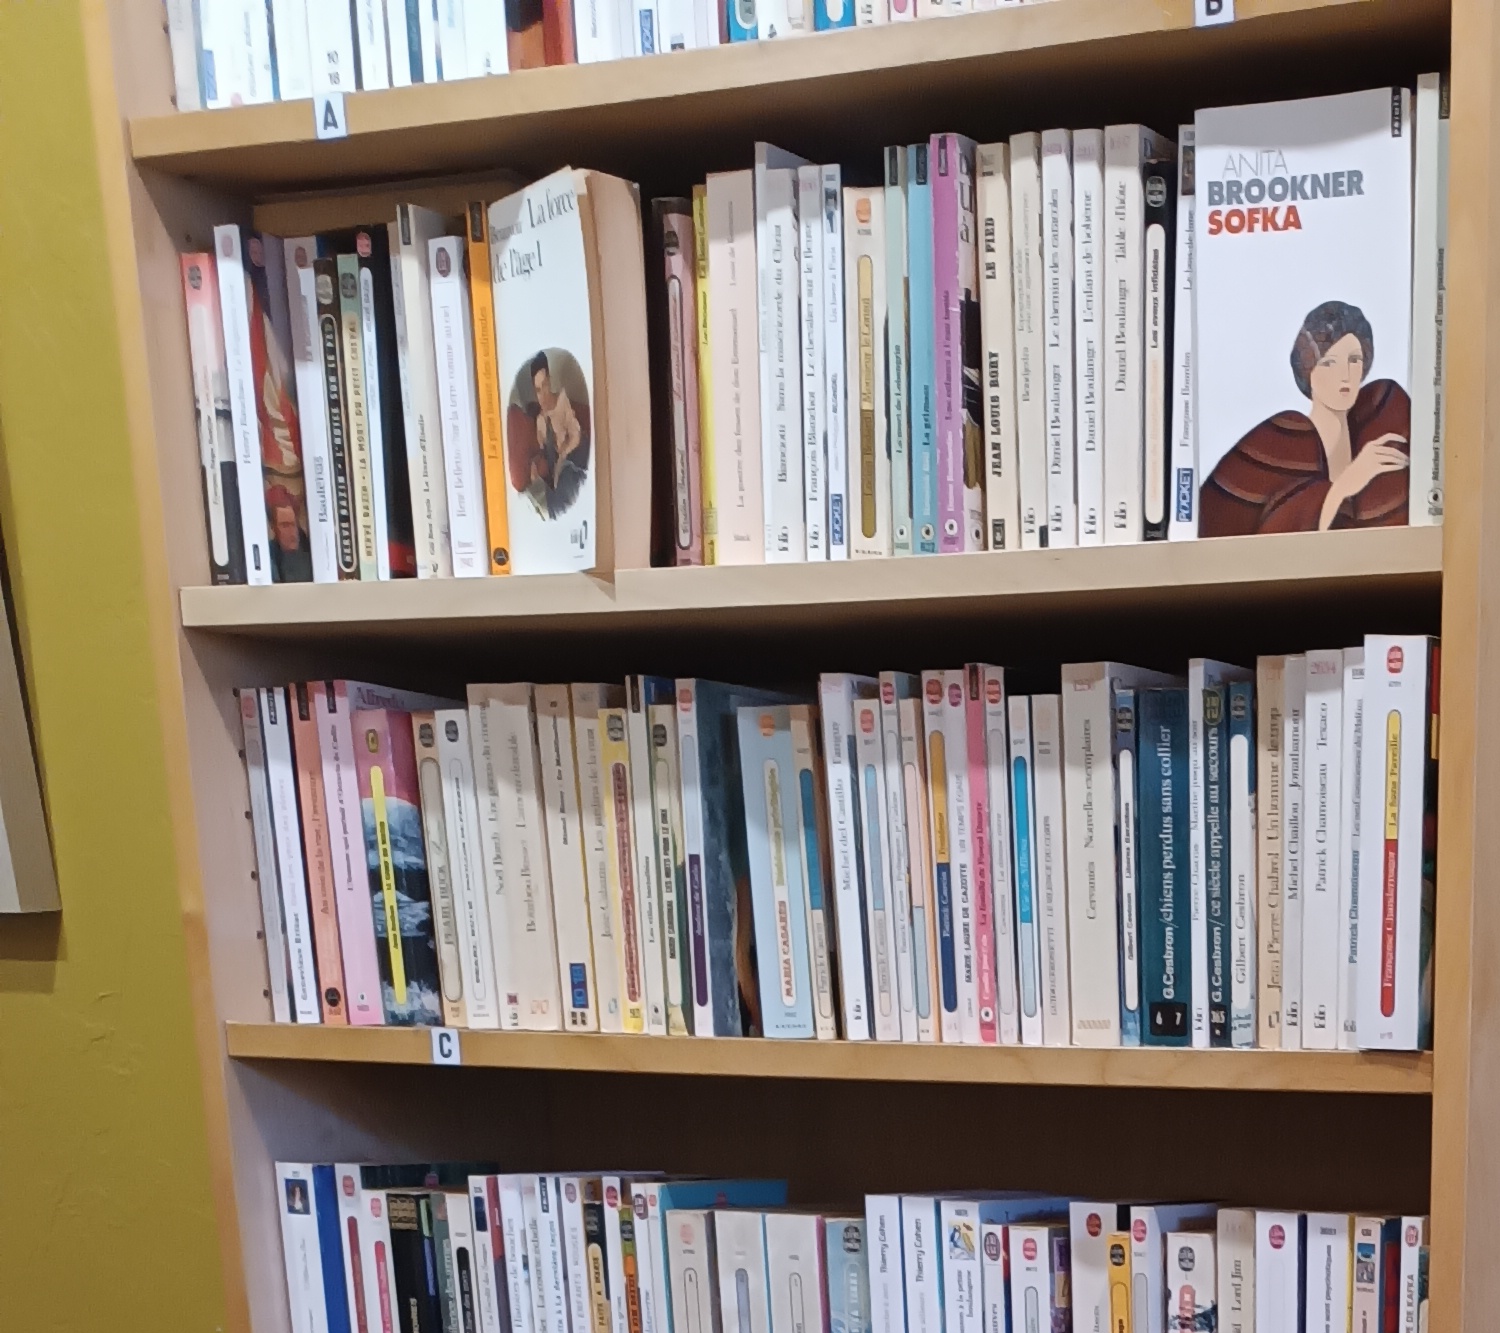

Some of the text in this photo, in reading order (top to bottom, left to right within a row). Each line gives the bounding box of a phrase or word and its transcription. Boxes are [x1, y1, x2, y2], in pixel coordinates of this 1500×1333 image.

[322, 100, 341, 131] A
[1222, 147, 1288, 178] ANITA
[1207, 169, 1364, 206] BROOKNER
[1207, 207, 1303, 236] SOFKA
[983, 217, 997, 280] LE PIED
[988, 395, 1001, 436] LOUIS
[989, 441, 1003, 478] JEAN
[1156, 725, 1172, 776] collier
[1206, 726, 1220, 783] secours
[1158, 778, 1172, 814] sans
[1314, 702, 1329, 893] Patrick Chamoiseau Texaco
[1157, 815, 1175, 870] perdus
[1207, 807, 1223, 858] appelle
[438, 1034, 452, 1060] C
[913, 1218, 925, 1284] Thierry Cohen
[1230, 1259, 1244, 1282] Jim
